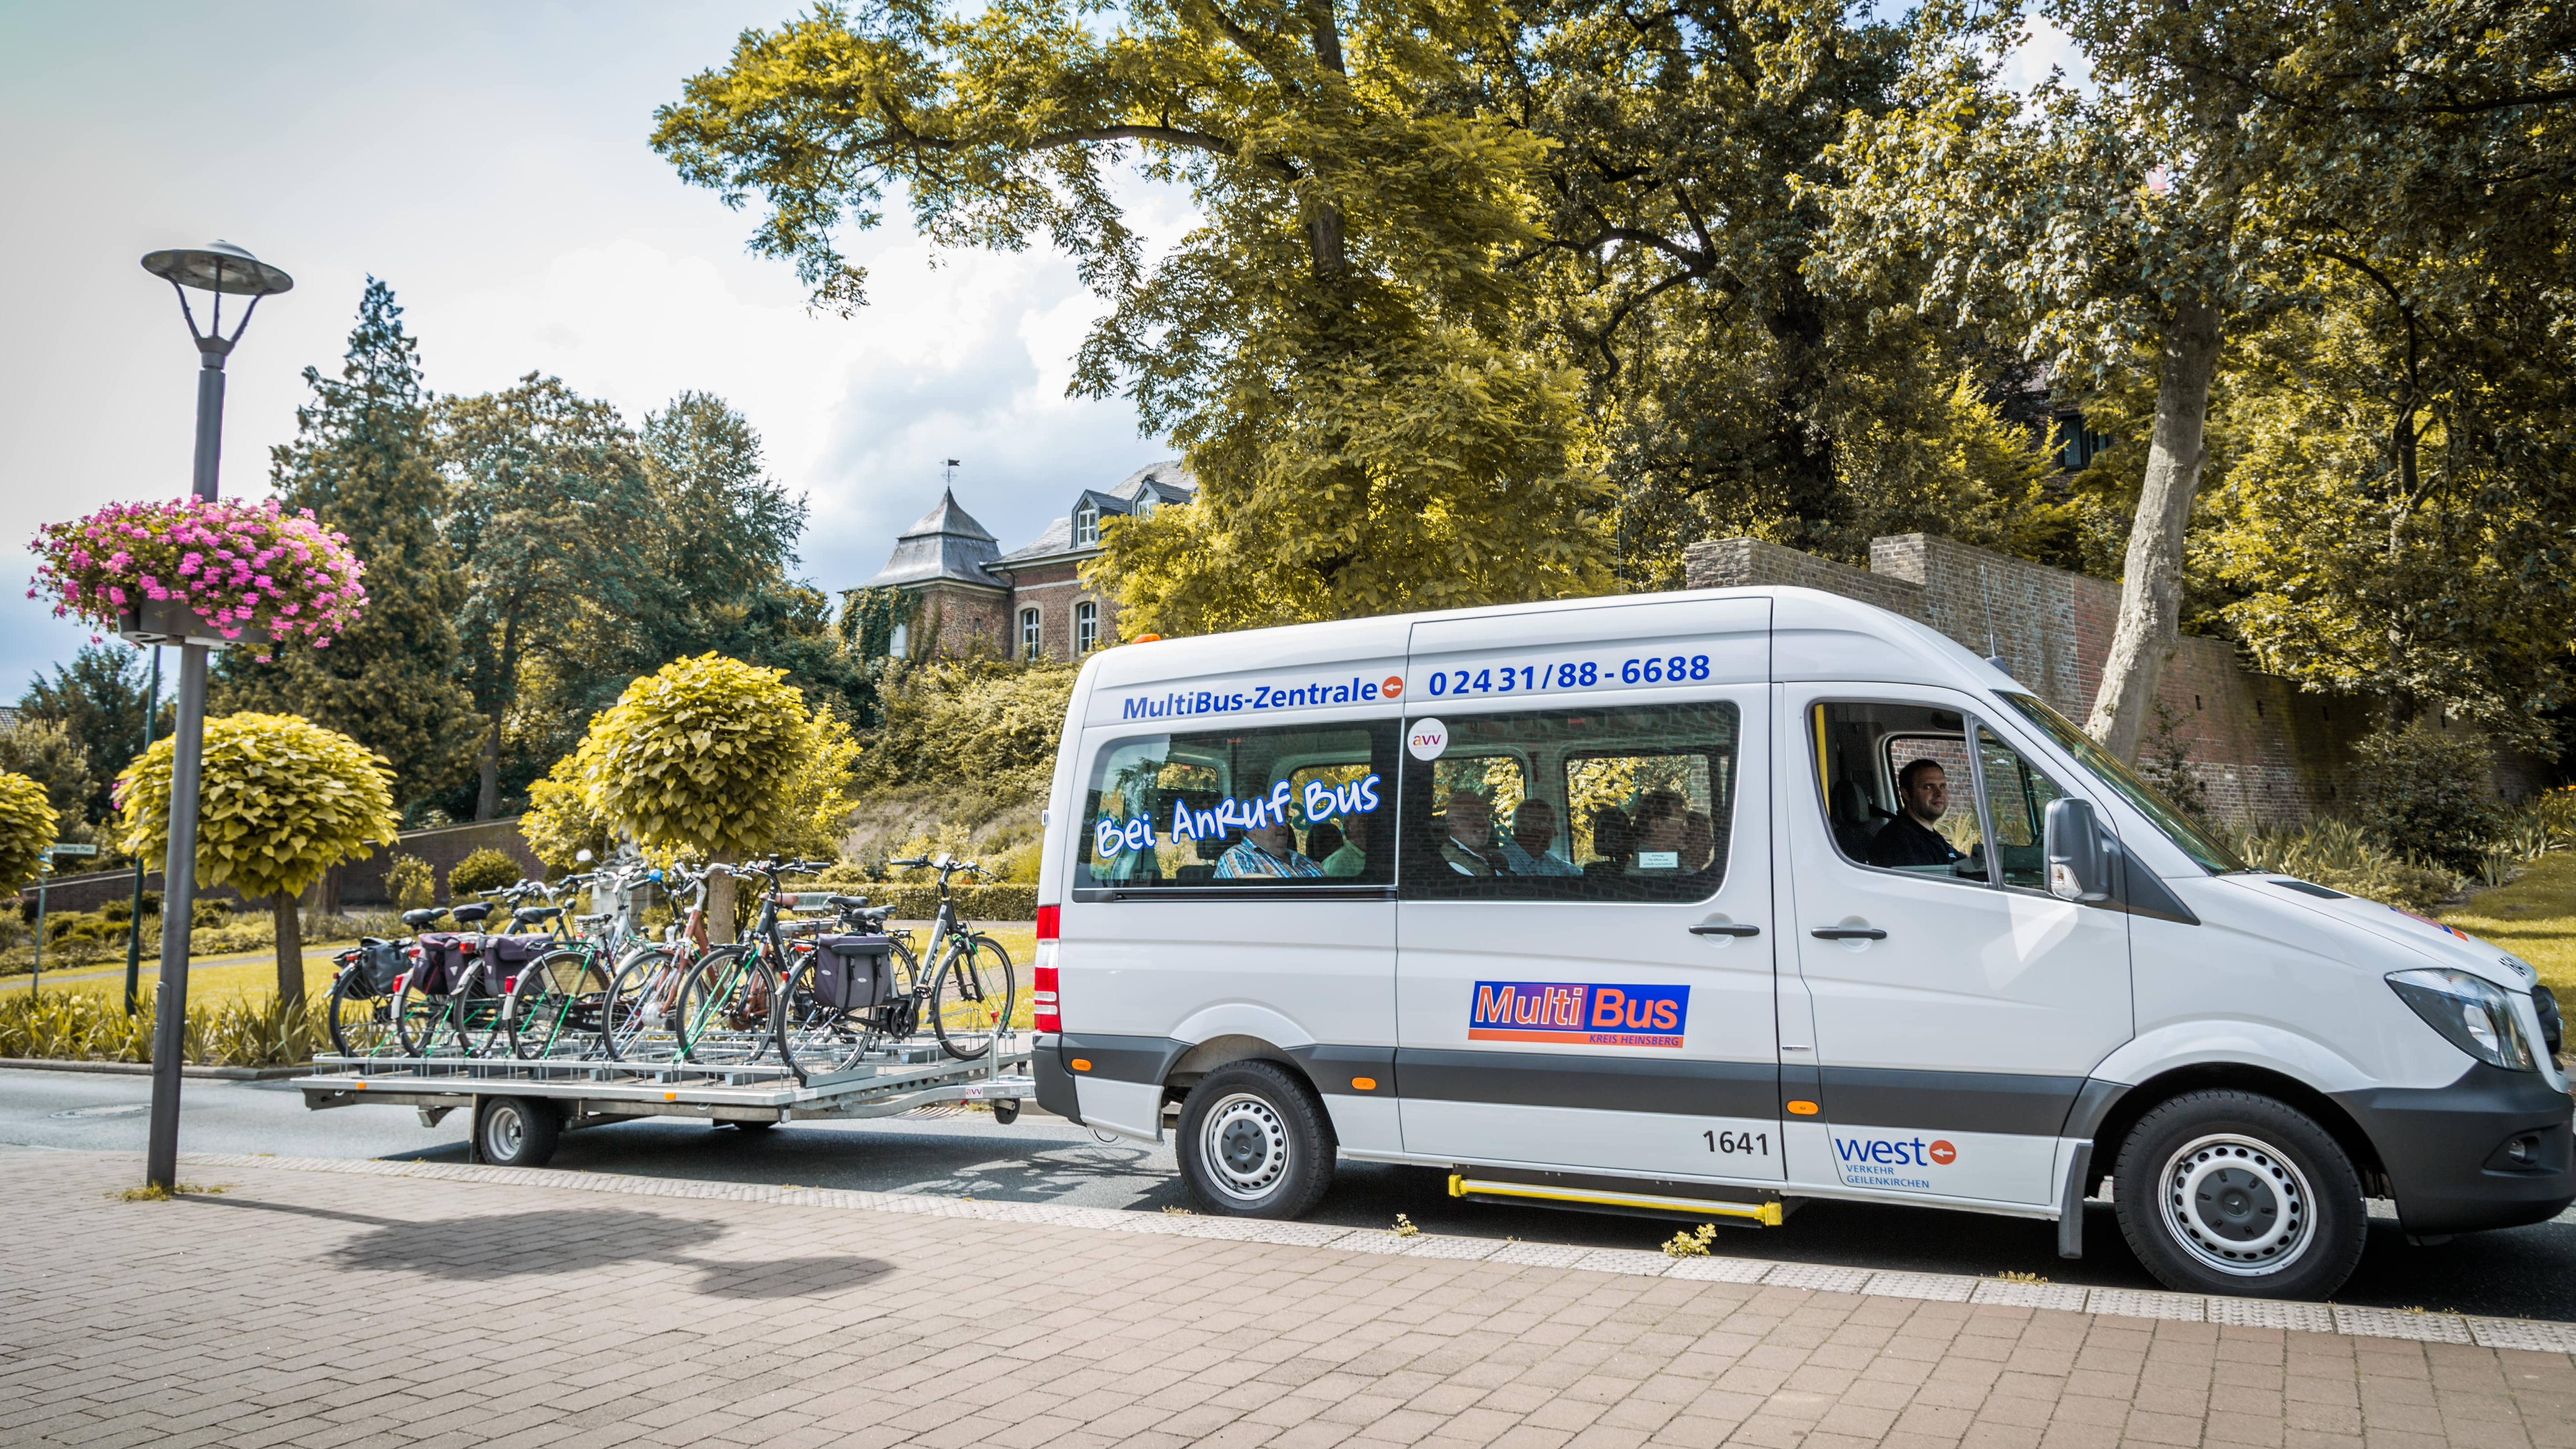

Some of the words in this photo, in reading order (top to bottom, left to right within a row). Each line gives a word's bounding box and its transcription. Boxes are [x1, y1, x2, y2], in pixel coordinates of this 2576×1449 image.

[1124, 677, 1378, 719] MultiBus-Zentrale
[1413, 734, 1441, 746] avv
[1095, 811, 1156, 859] Bei
[1303, 773, 1381, 824] Bus
[1475, 985, 1583, 1026] Multi
[1591, 988, 1679, 1029] Bus
[1589, 1034, 1617, 1044] KREIS
[1621, 1035, 1679, 1046] HEINSBERG
[1703, 1130, 1768, 1156] 1641
[1835, 1137, 1928, 1166] west
[1846, 1164, 1894, 1175] VERKEHR
[1846, 1175, 1930, 1188] GEILENKIRCHEN
